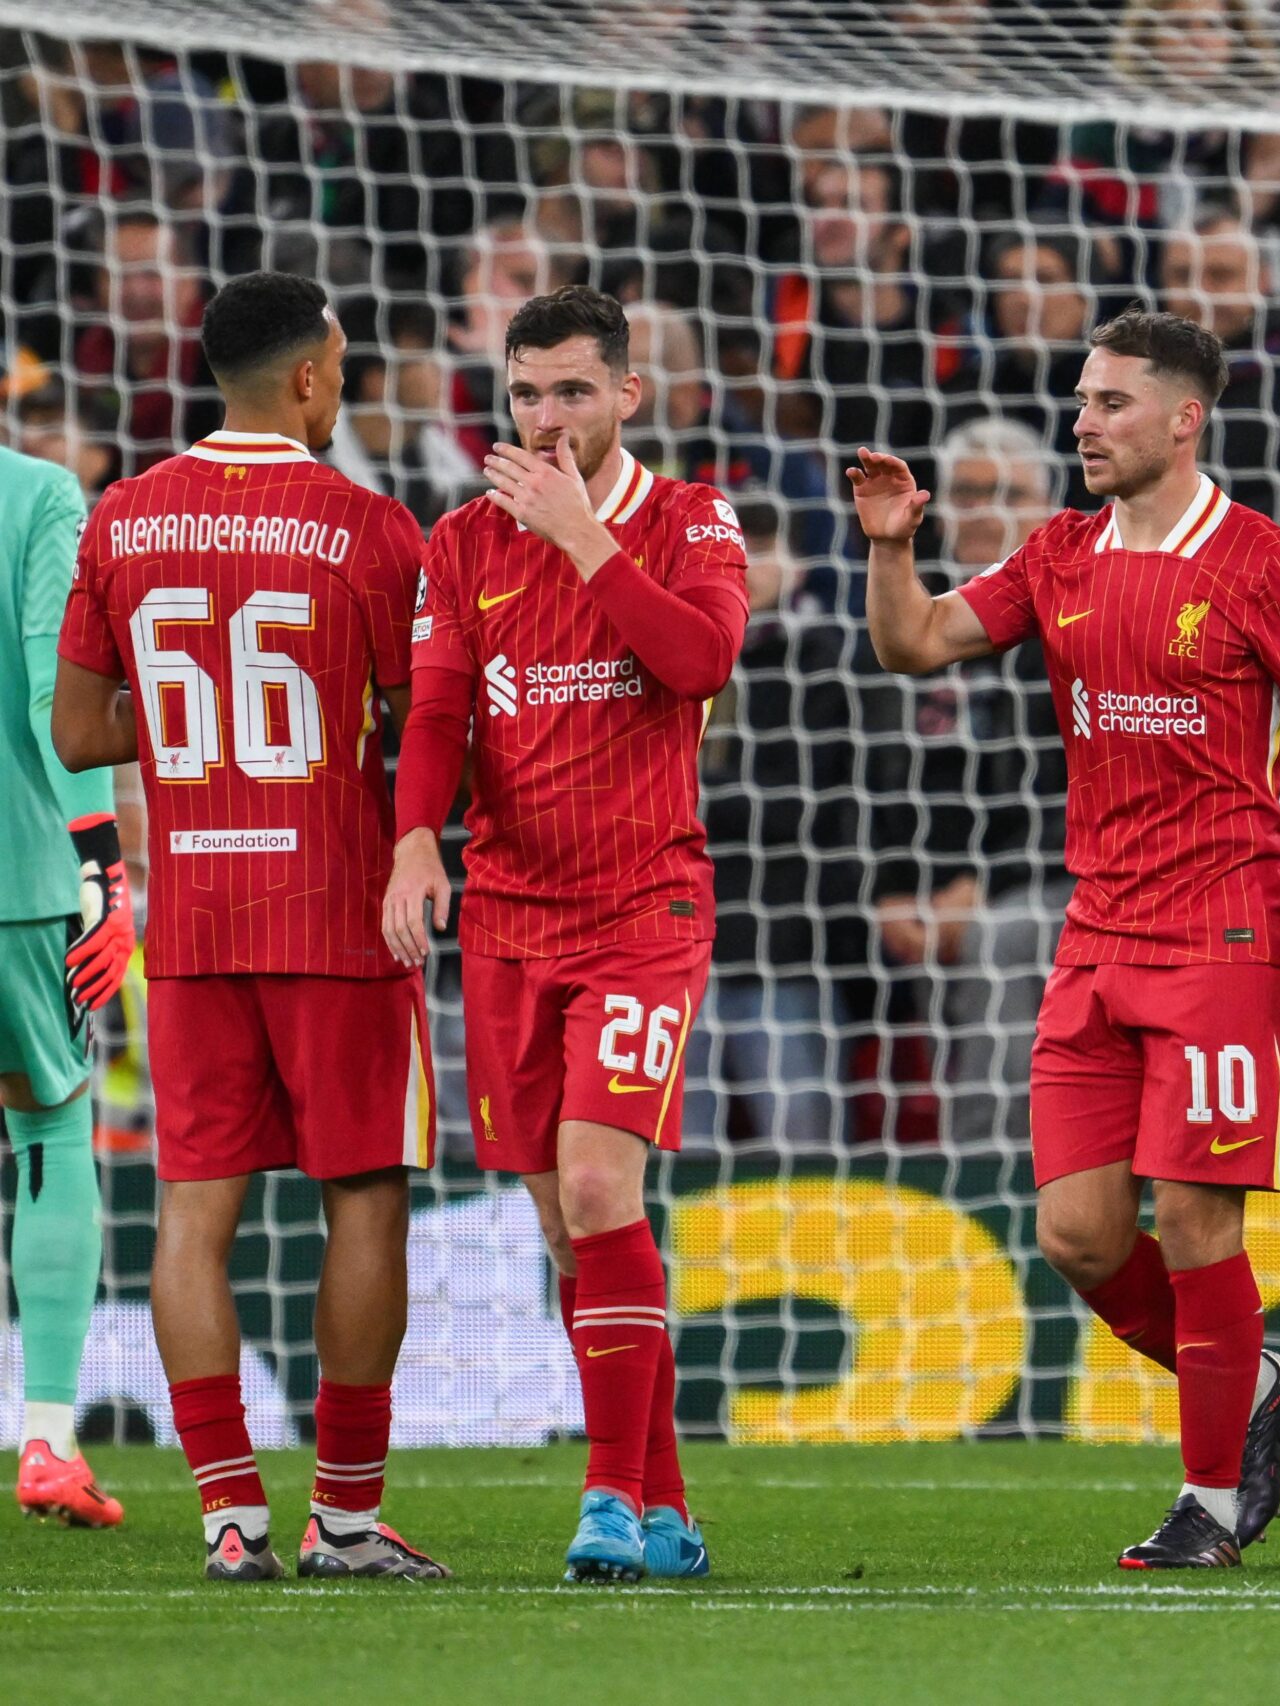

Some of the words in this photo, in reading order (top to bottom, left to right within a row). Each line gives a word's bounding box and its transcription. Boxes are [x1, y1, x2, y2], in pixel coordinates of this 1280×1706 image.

[110, 514, 350, 565] ALEXANDER-ARNOLD
[525, 656, 634, 684] standard
[129, 587, 327, 785] 66
[525, 676, 643, 705] chartered
[1098, 690, 1198, 714] standard
[1098, 712, 1206, 735] chartered
[192, 833, 290, 849] Foundation
[598, 994, 681, 1084] 26
[1184, 1045, 1258, 1124] 10
[206, 1496, 232, 1512] LFC
